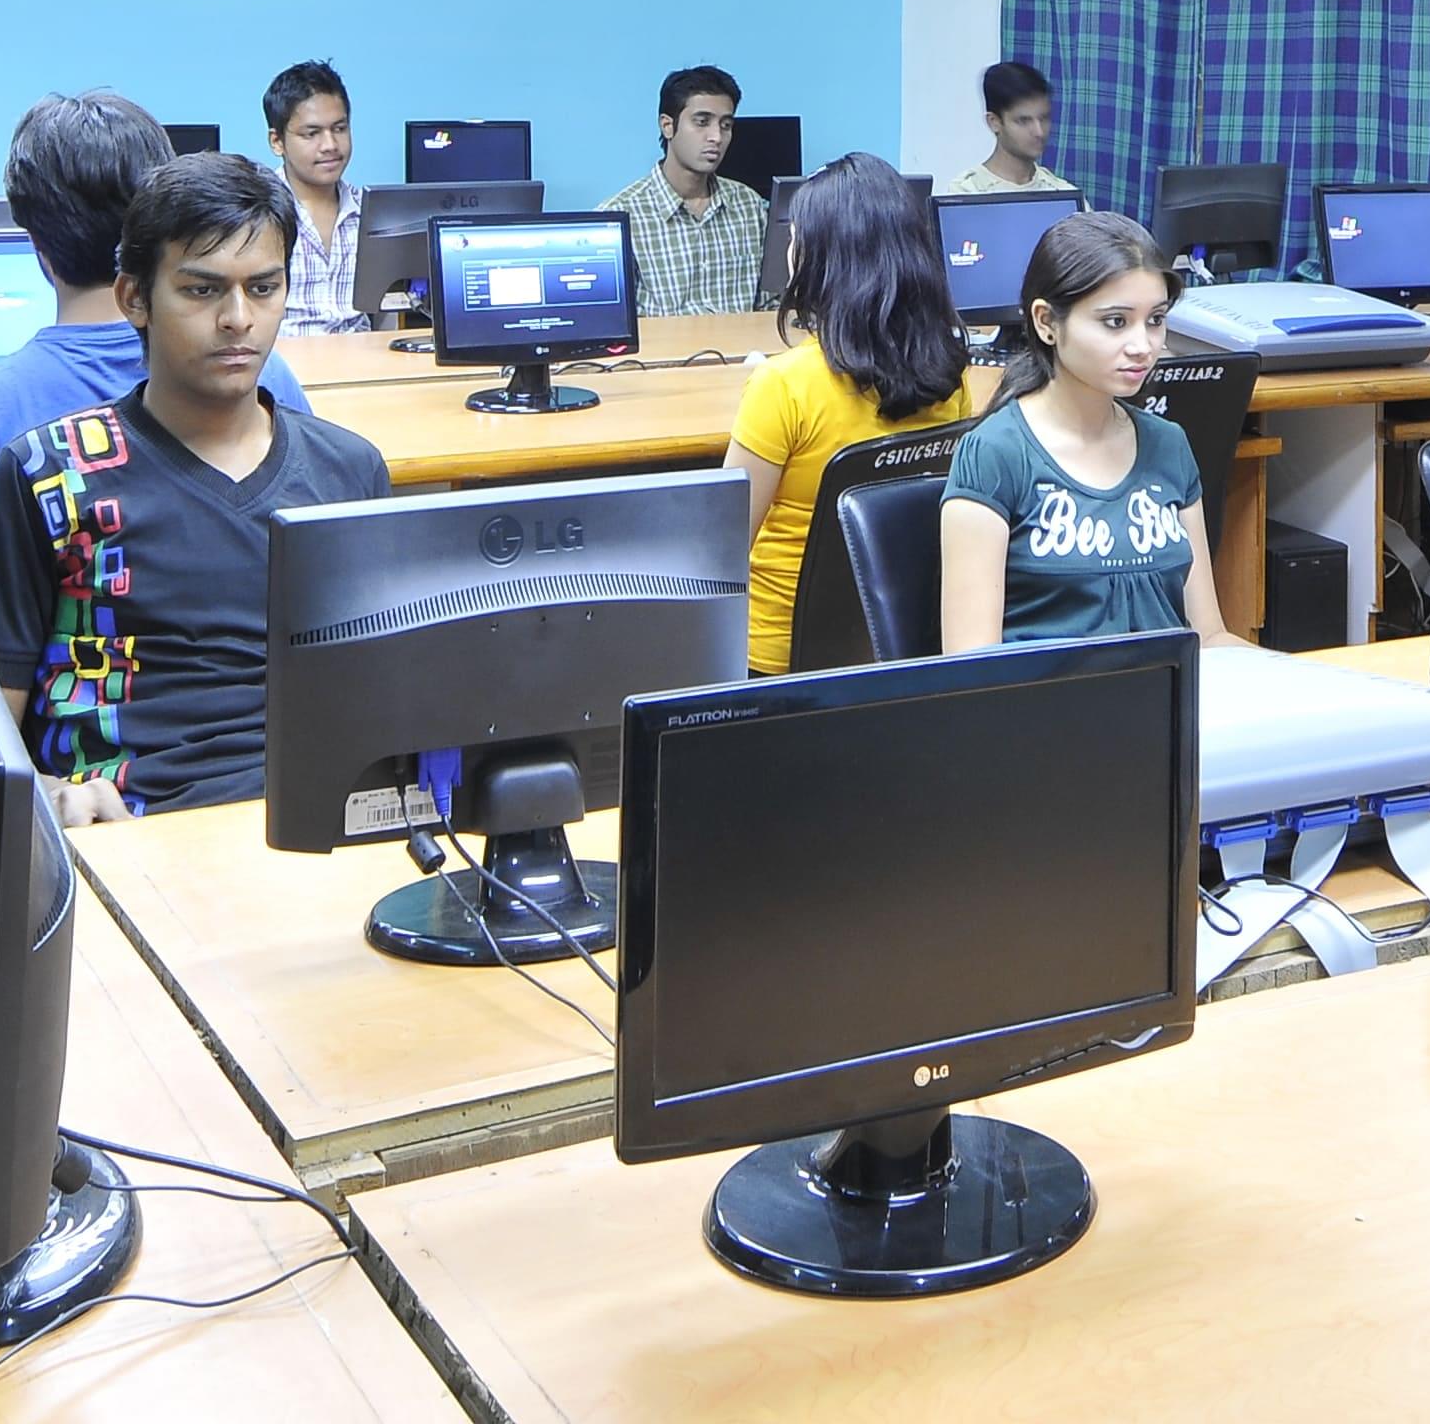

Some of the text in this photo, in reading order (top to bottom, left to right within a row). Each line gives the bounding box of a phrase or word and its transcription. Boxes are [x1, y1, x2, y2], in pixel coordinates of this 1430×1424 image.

[460, 195, 480, 208] LG
[1144, 396, 1168, 414] 24
[1030, 489, 1115, 557] Bee
[534, 517, 584, 554] LG
[668, 708, 732, 727] FLATRON
[932, 1064, 949, 1080] LG
